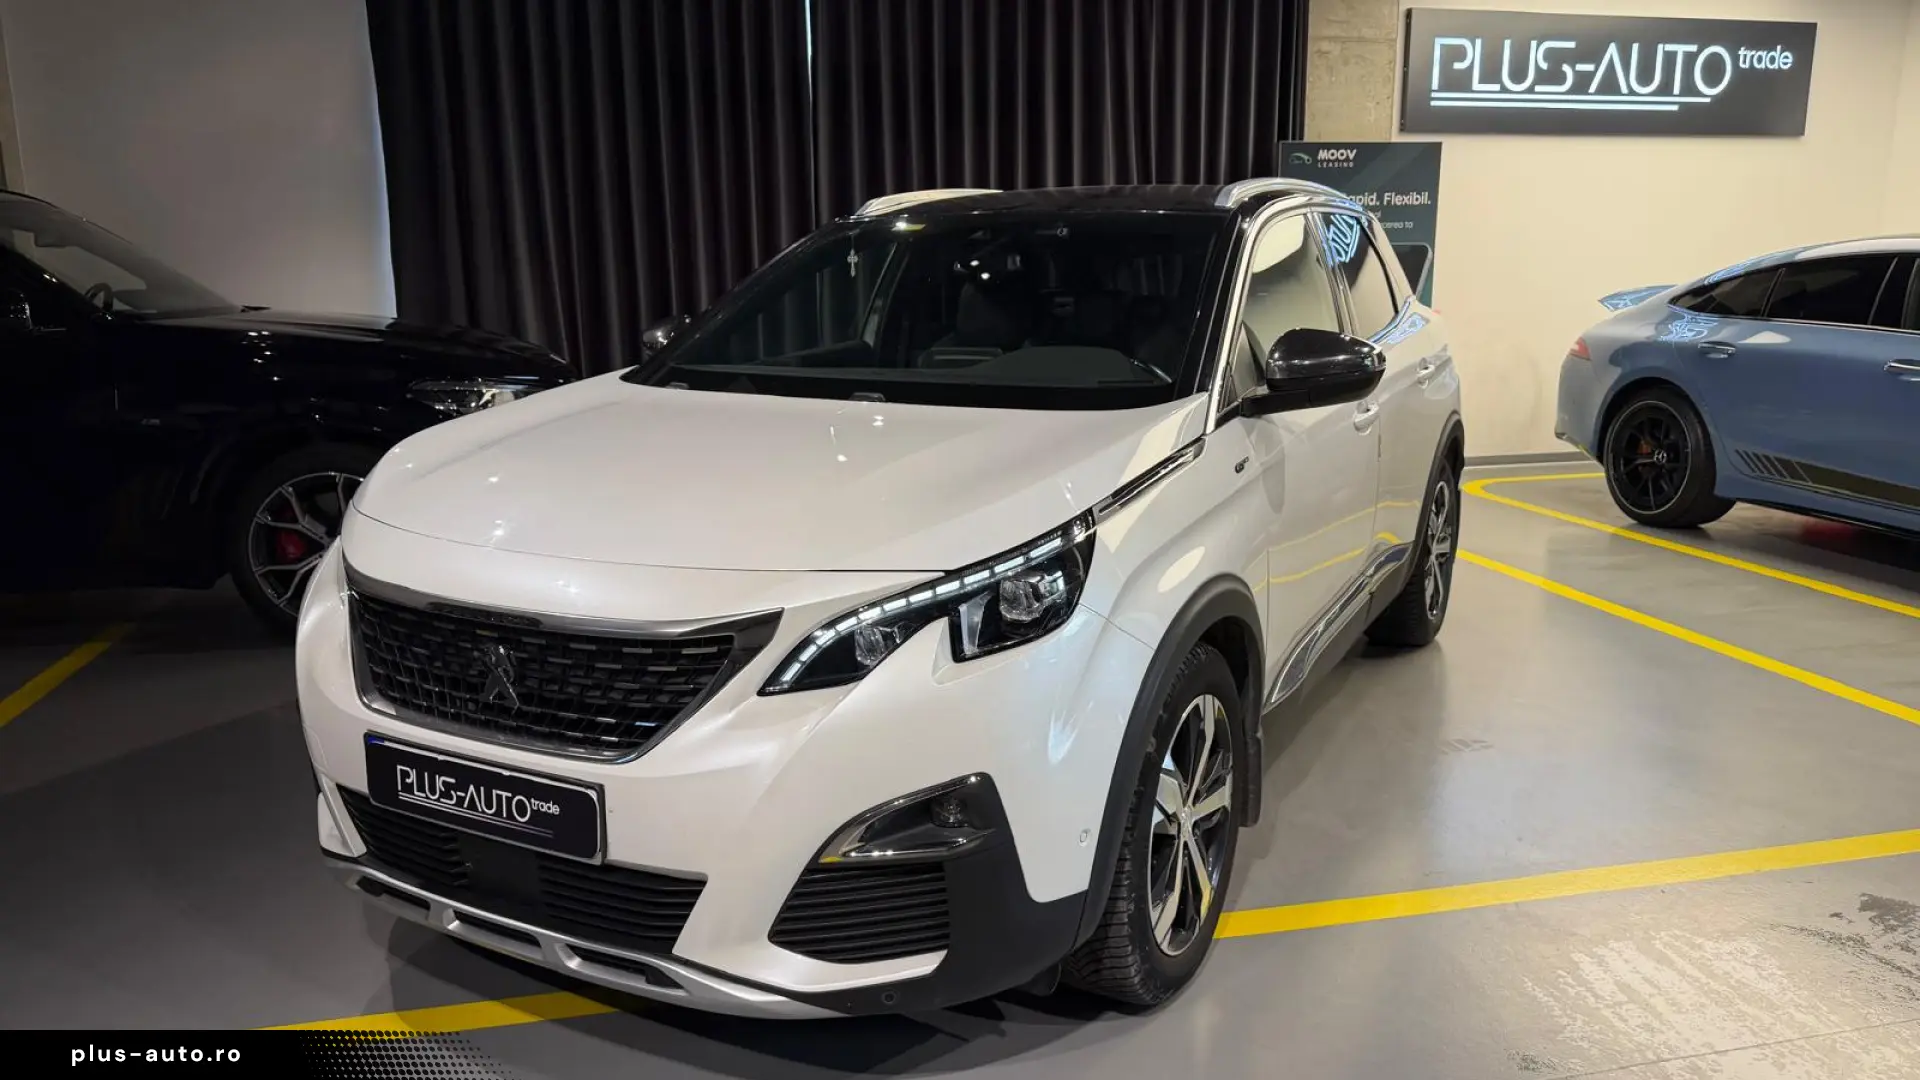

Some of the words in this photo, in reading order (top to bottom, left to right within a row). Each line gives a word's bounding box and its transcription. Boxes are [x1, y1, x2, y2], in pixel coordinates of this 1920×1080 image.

[1430, 37, 1731, 96] PLUS-AUTO
[1737, 45, 1793, 69] trade
[1317, 149, 1357, 160] MOOV
[1383, 191, 1431, 206] Flexibil.
[396, 765, 531, 822] PLUS-AUTO
[530, 797, 560, 815] trade
